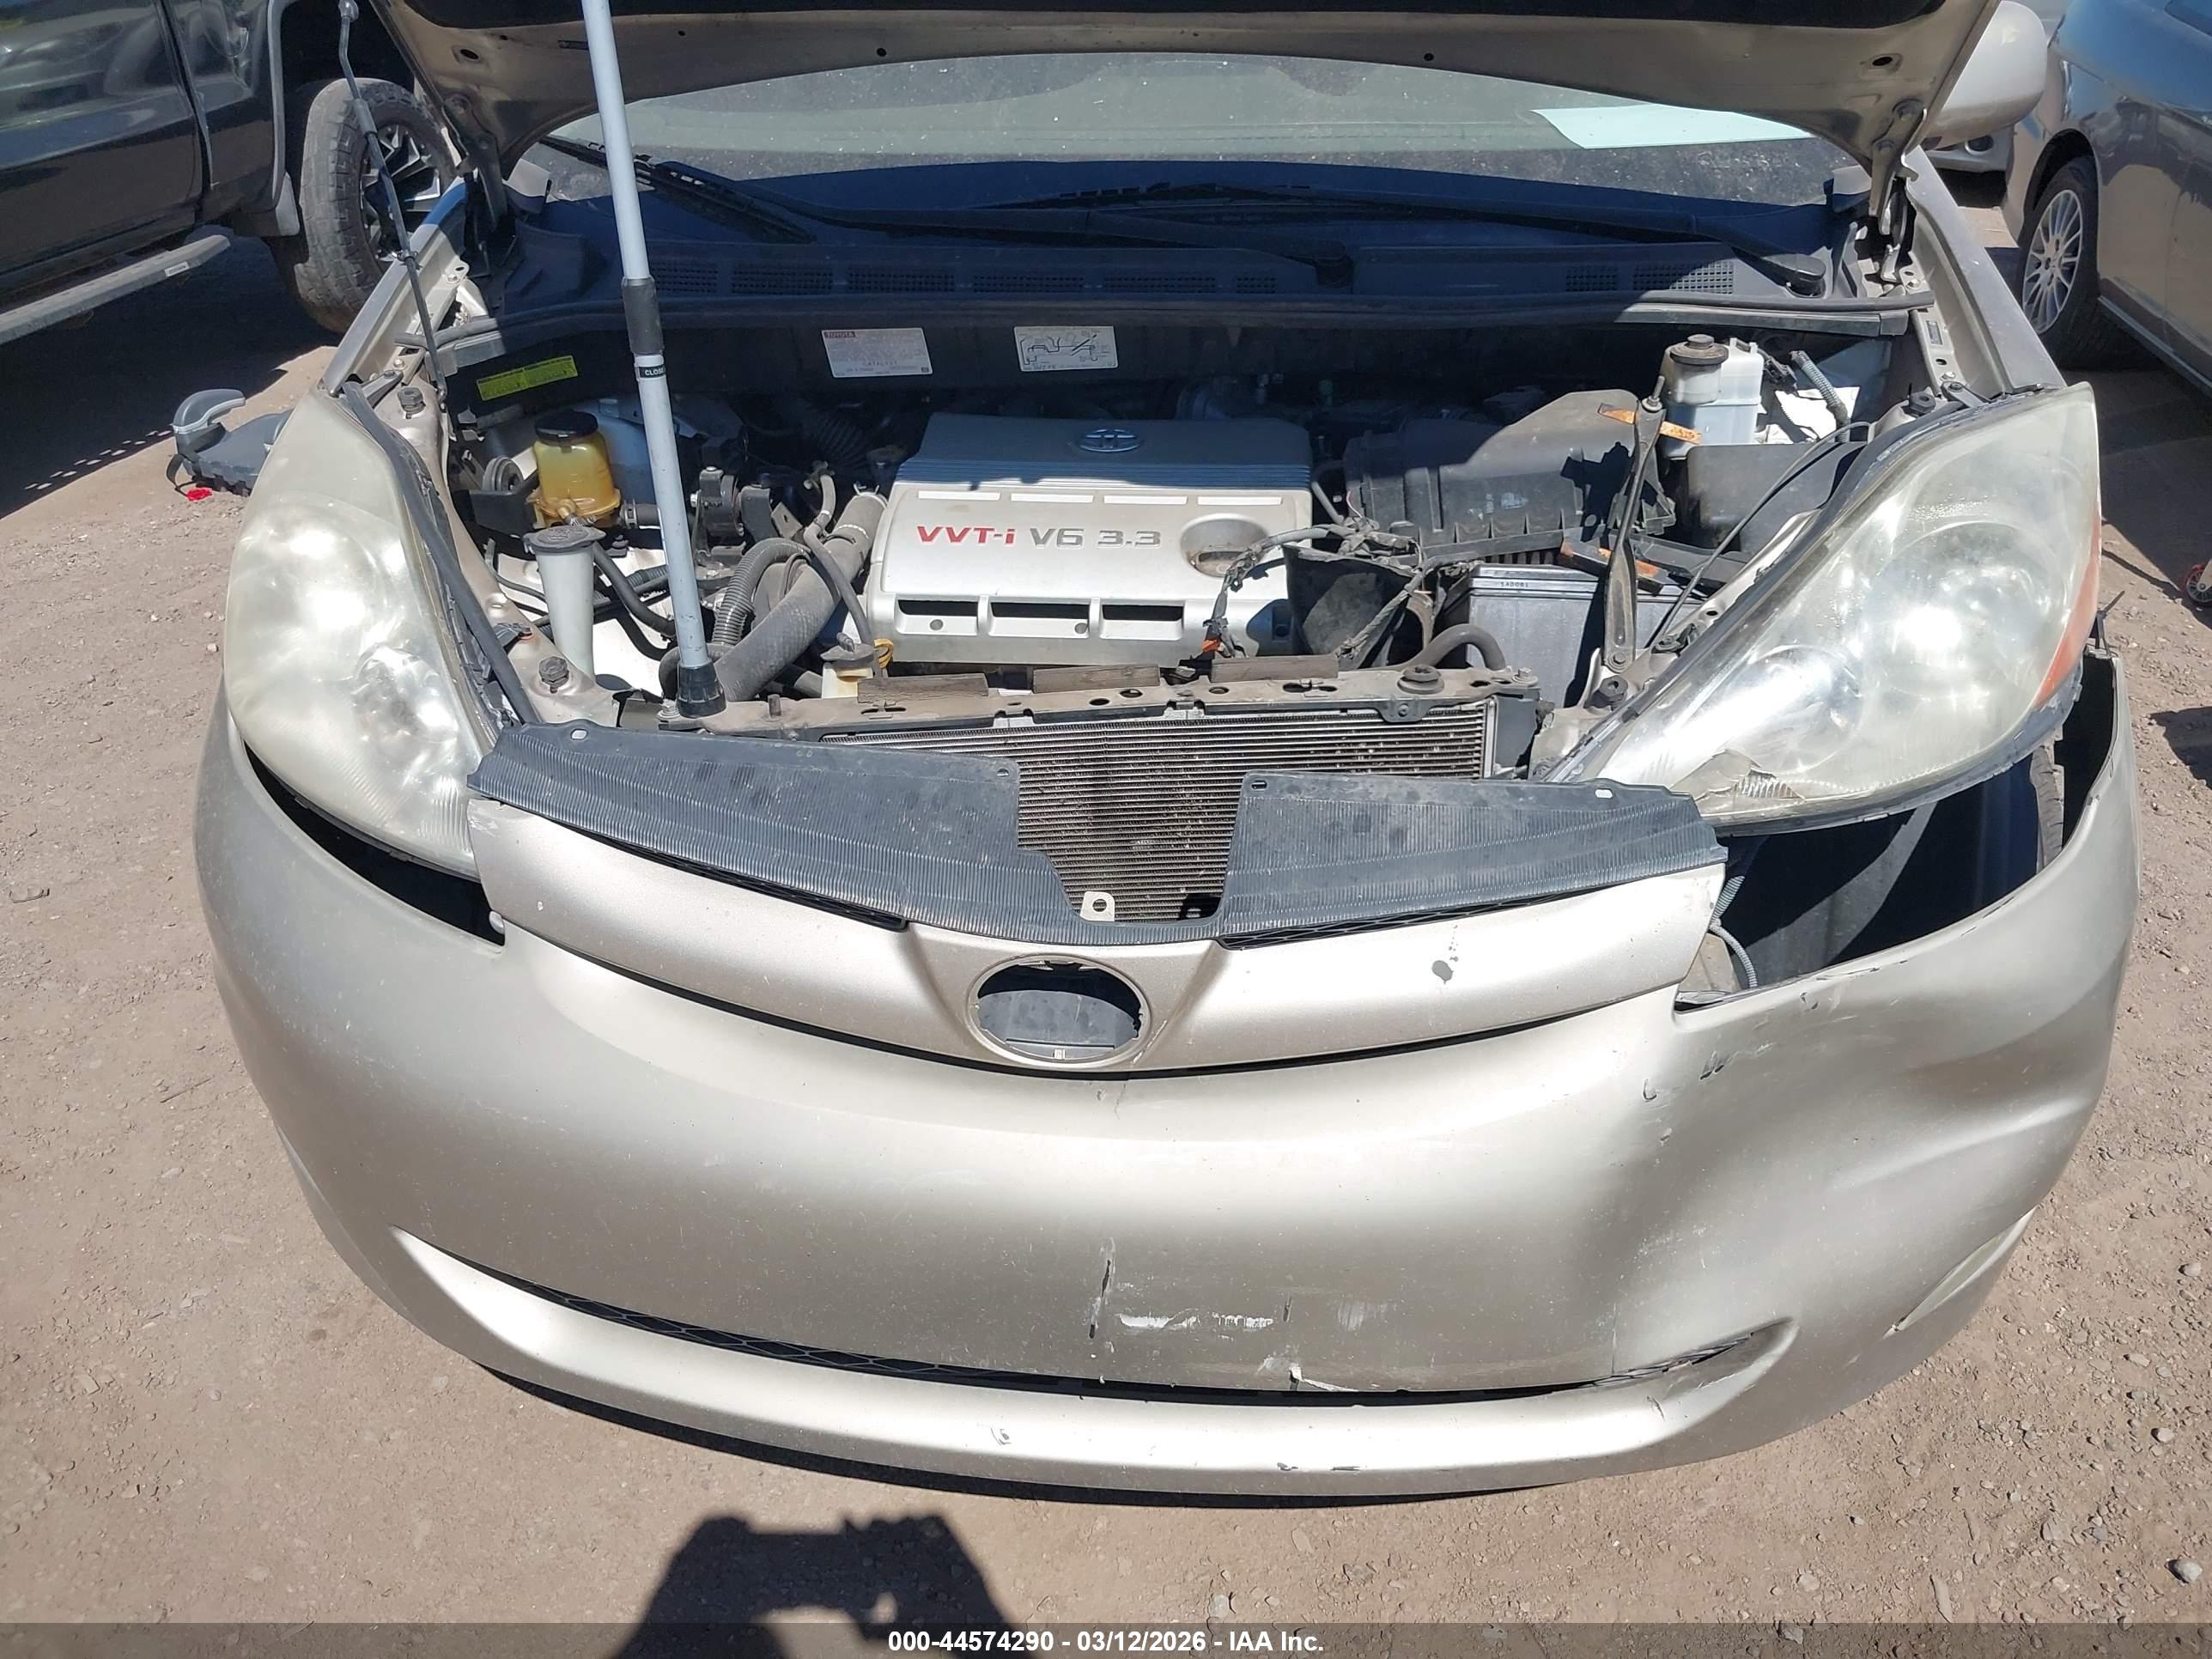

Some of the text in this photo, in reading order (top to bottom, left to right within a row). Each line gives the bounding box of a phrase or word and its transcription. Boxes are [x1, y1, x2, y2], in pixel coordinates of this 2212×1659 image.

[916, 526, 1163, 549] VVT-i V6 3.3
